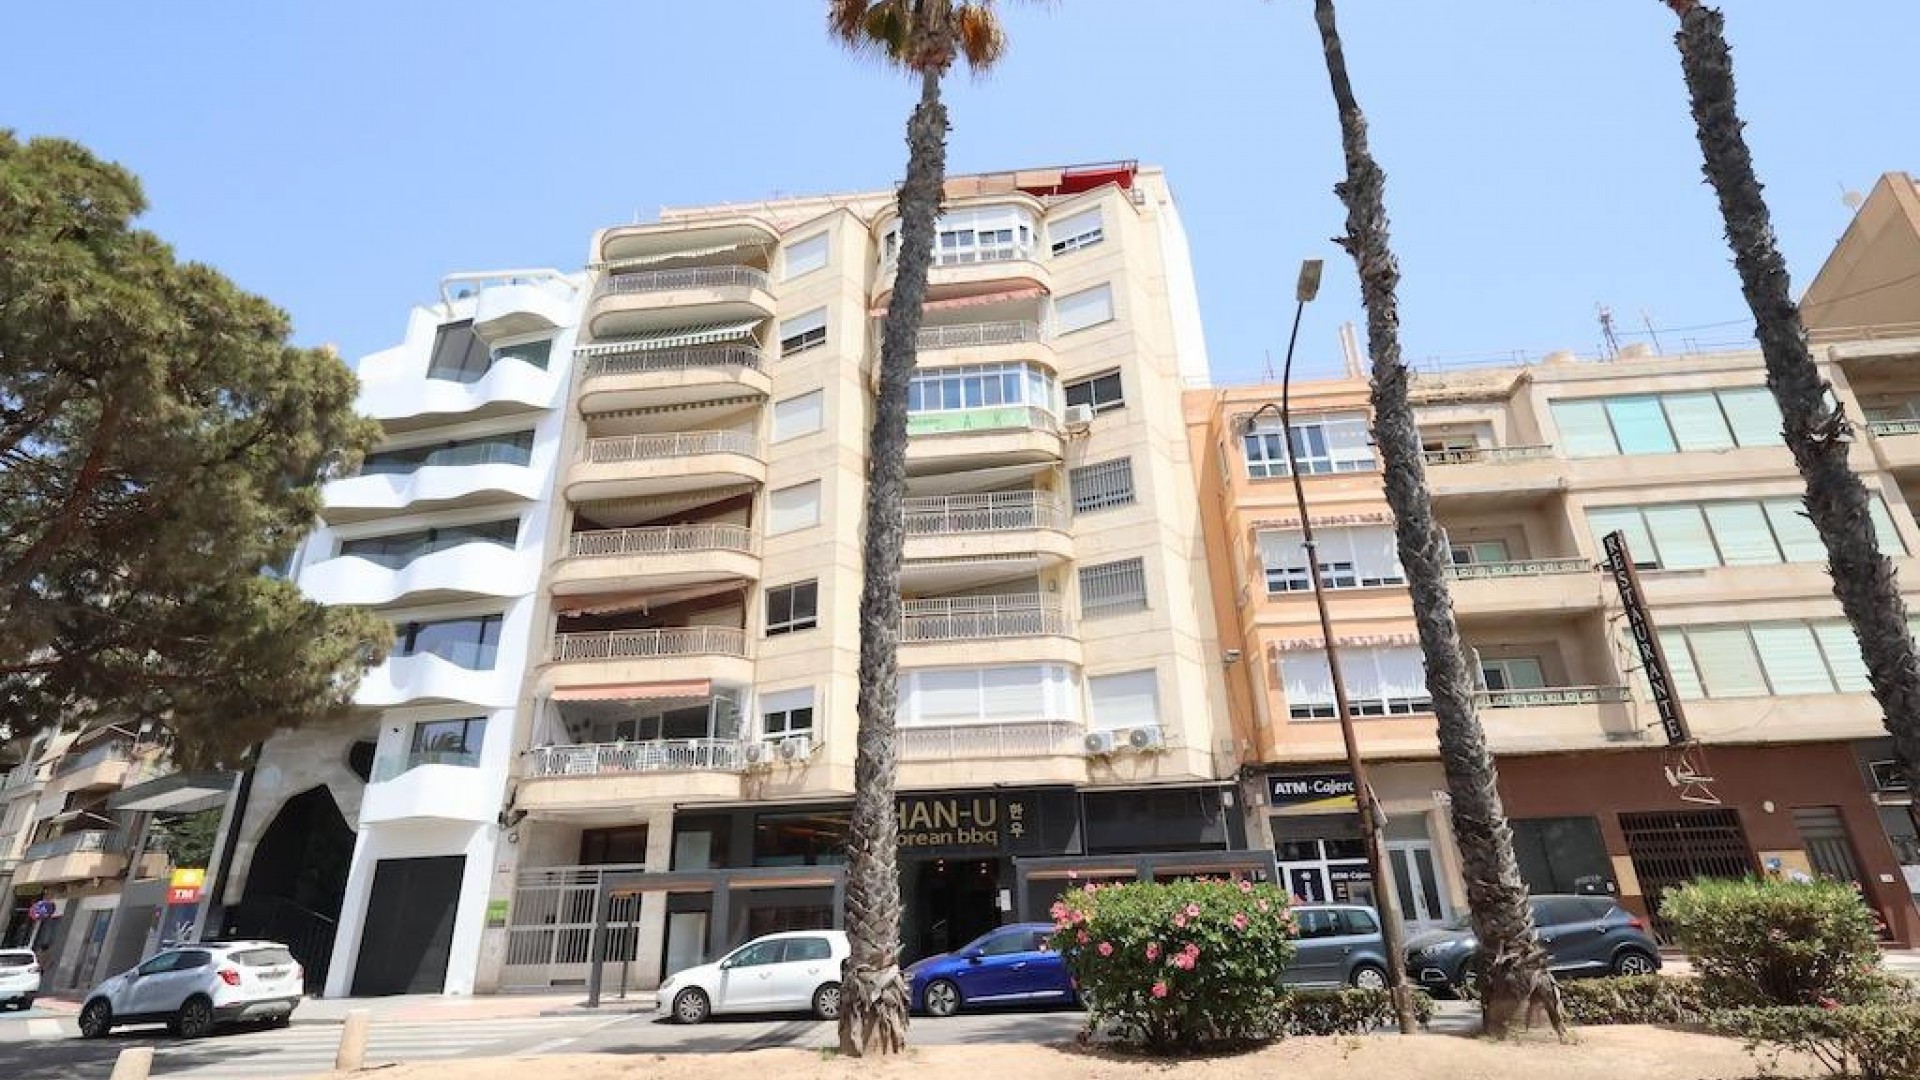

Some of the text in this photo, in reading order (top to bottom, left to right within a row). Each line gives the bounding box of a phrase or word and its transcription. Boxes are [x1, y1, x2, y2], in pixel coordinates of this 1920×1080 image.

[1606, 536, 1681, 738] RESTAURANTE
[1275, 782, 1308, 795] ATM
[896, 828, 998, 846] orean bbq
